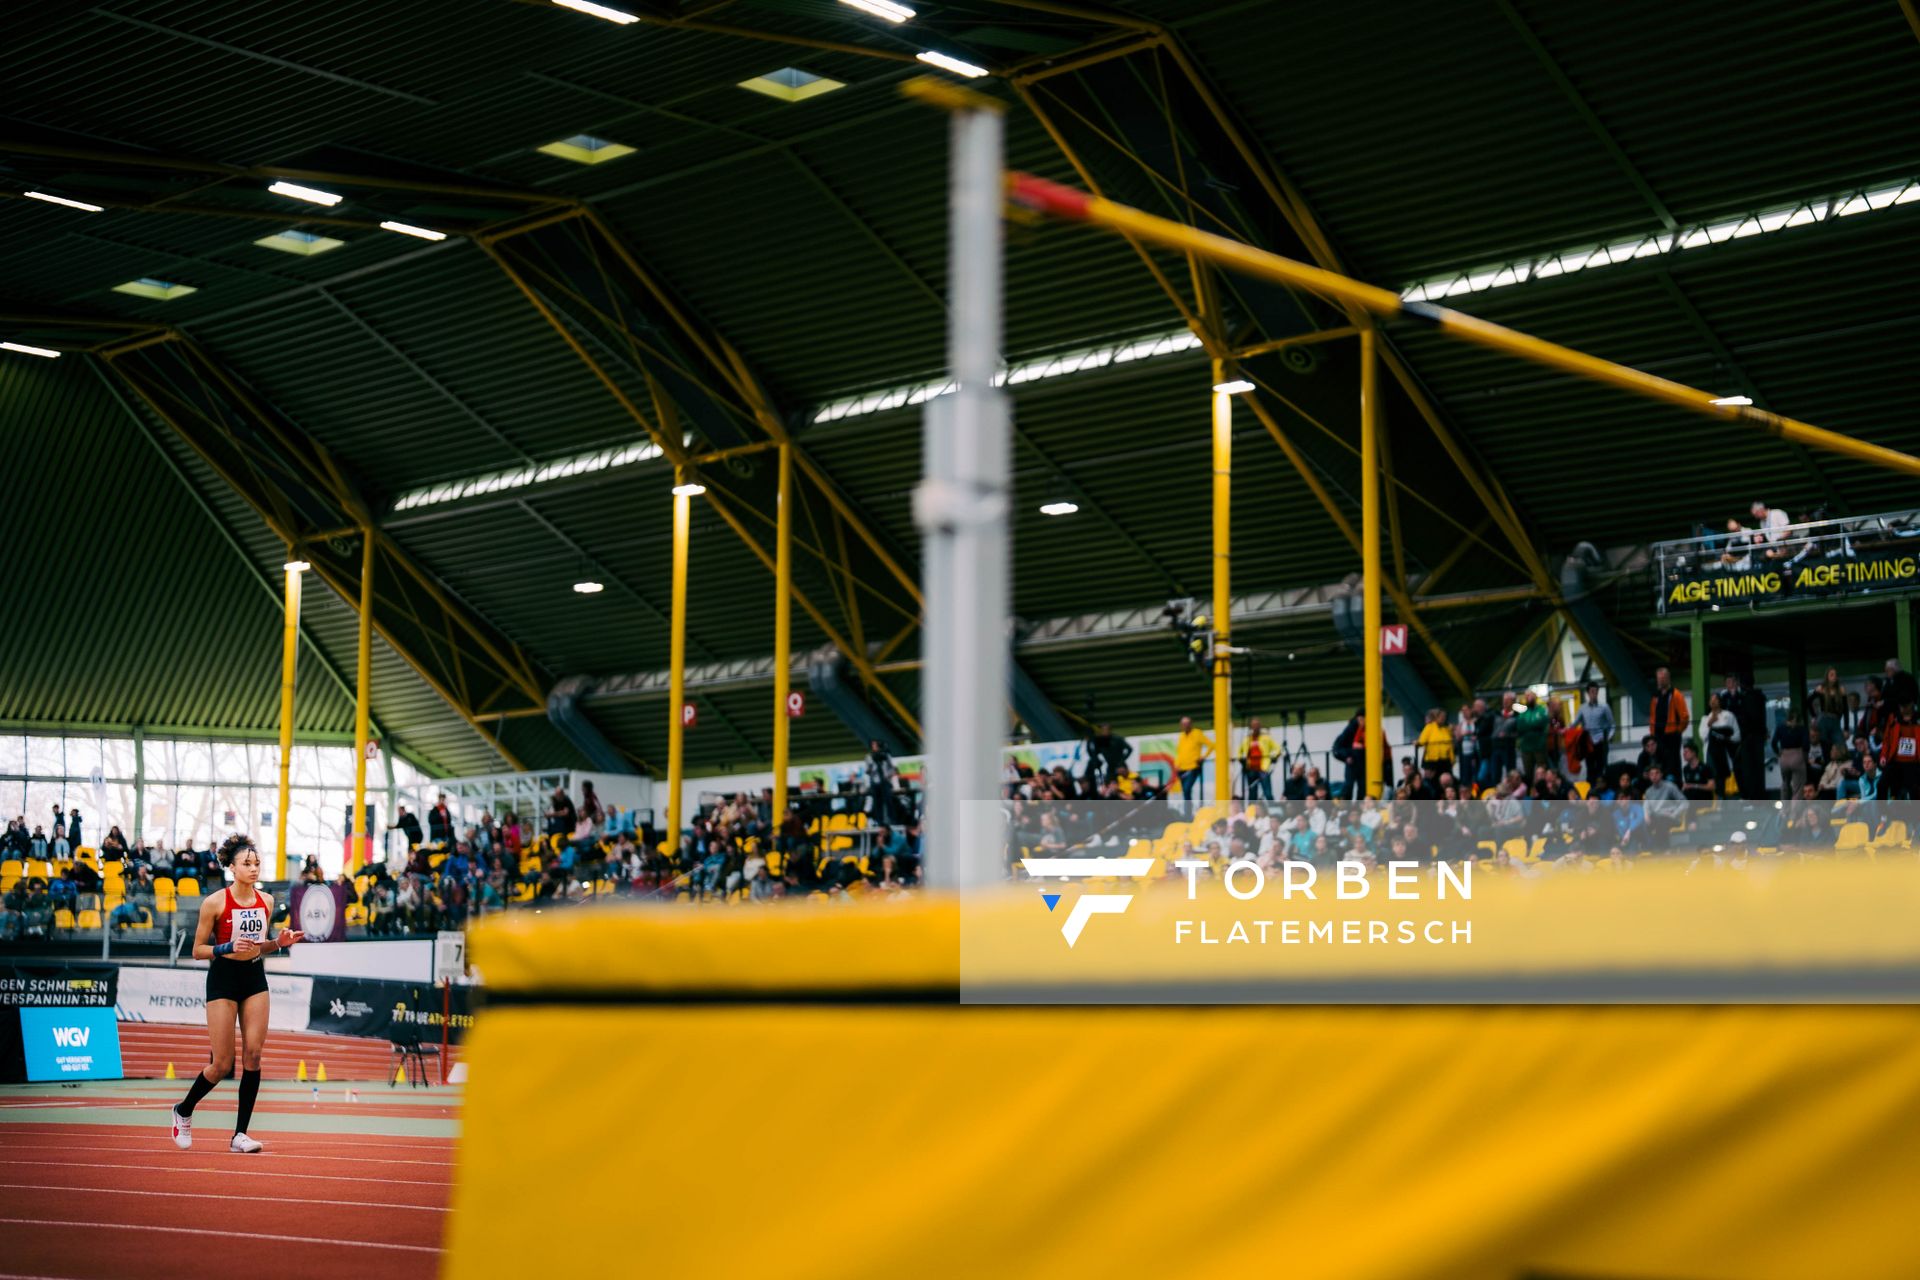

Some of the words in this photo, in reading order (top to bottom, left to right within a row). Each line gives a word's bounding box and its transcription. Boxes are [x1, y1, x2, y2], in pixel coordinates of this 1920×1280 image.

[1385, 627, 1404, 650] N
[684, 705, 695, 724] P
[240, 909, 258, 919] GLS
[239, 919, 262, 932] 409
[455, 944, 463, 962] 7
[29, 979, 108, 993] SCHMEEN
[0, 992, 107, 1006] ERSPANNUNEN
[52, 1026, 90, 1047] WGV
